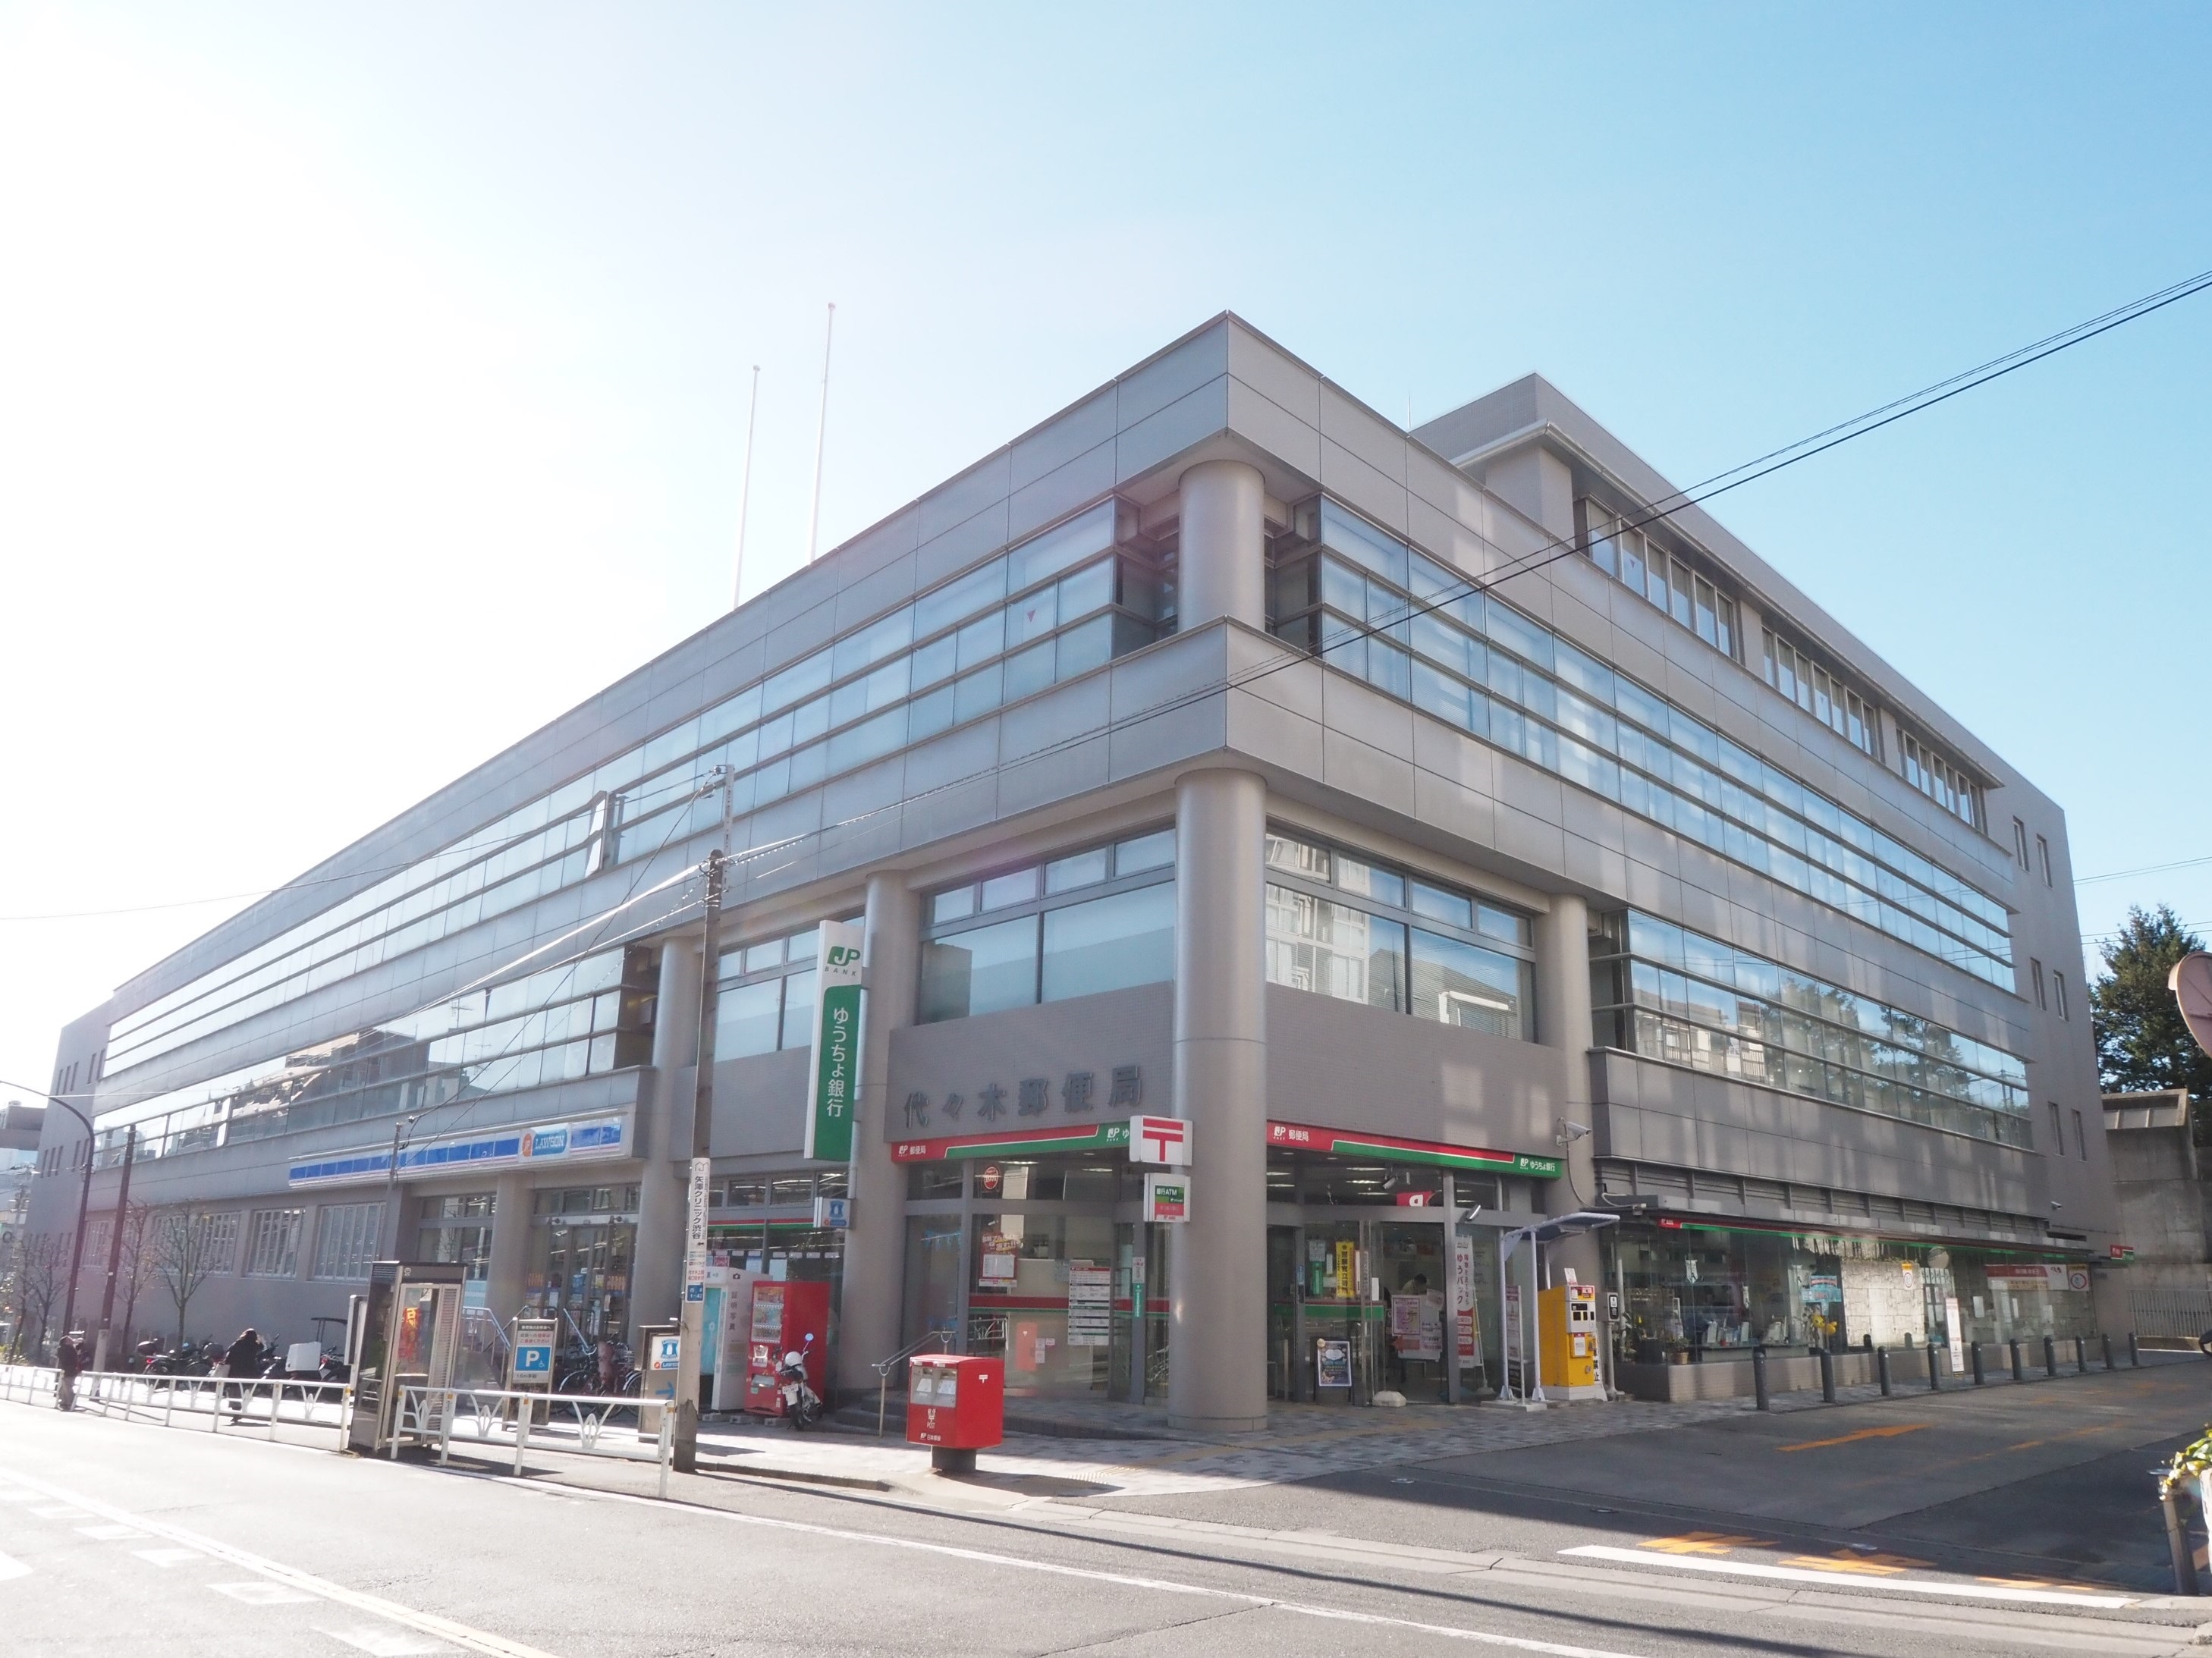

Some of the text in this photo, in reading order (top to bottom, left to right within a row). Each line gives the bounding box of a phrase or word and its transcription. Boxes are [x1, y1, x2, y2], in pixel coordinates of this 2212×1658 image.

[824, 966, 856, 977] BANK
[827, 1007, 849, 1117] ゆうちょ銀行
[904, 1065, 1142, 1129] 代々木郵便局
[535, 1135, 565, 1150] LAWSON
[1288, 1129, 1309, 1141] 郵便局
[1529, 1160, 1556, 1172] ゆうちょ銀行
[526, 1350, 539, 1367] P
